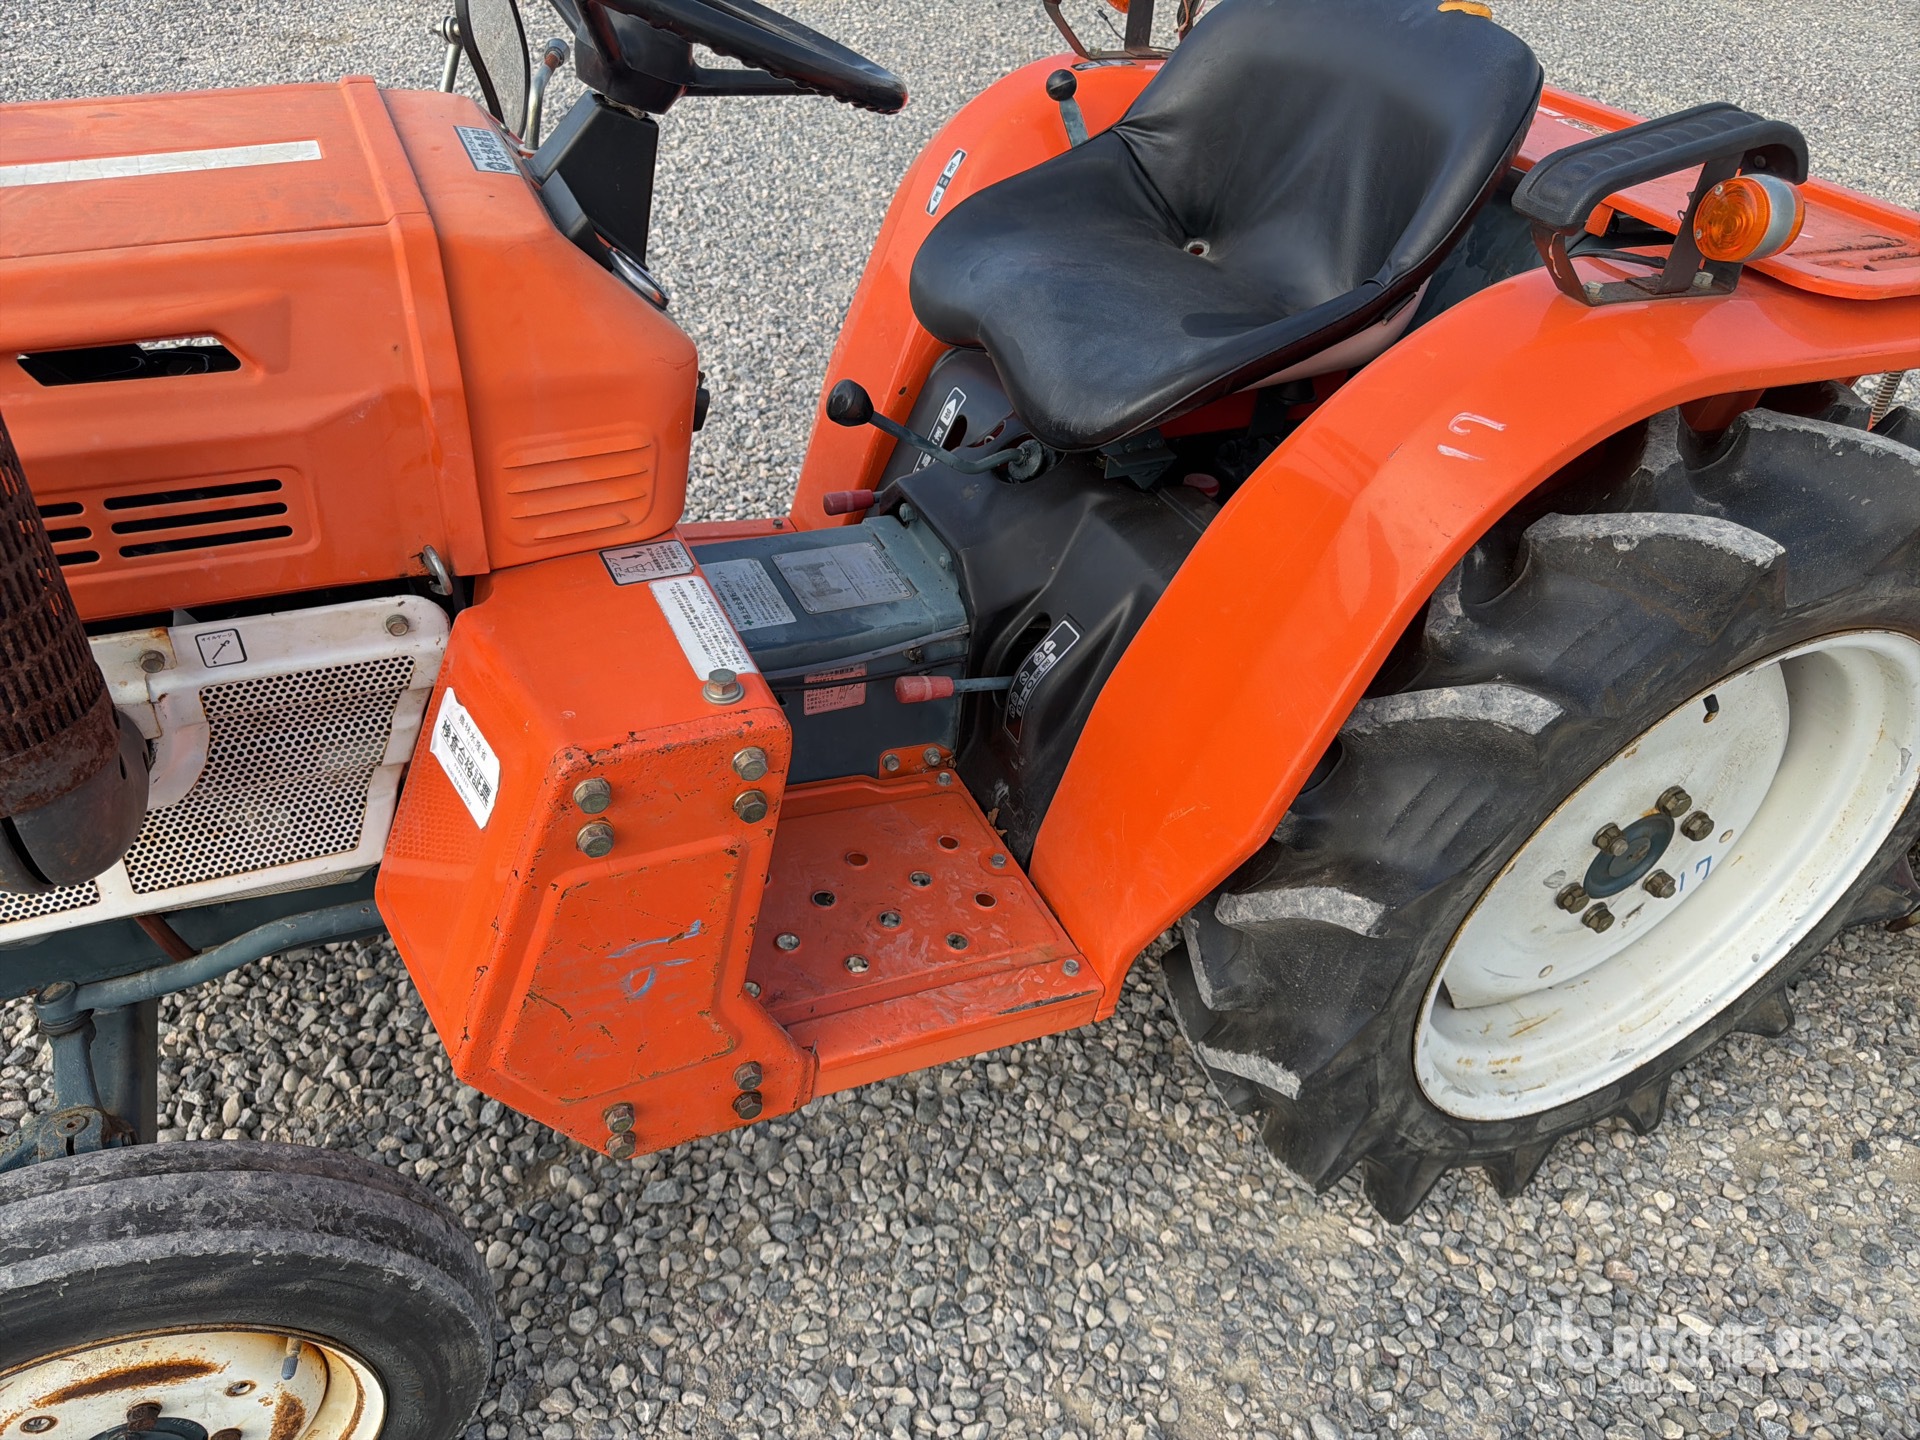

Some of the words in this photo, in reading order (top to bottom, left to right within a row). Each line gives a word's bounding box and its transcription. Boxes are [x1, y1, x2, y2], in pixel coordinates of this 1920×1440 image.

[201, 632, 232, 642] オイルゲージ
[442, 719, 492, 806] 検査合格証票
[1679, 855, 1712, 892] 17
